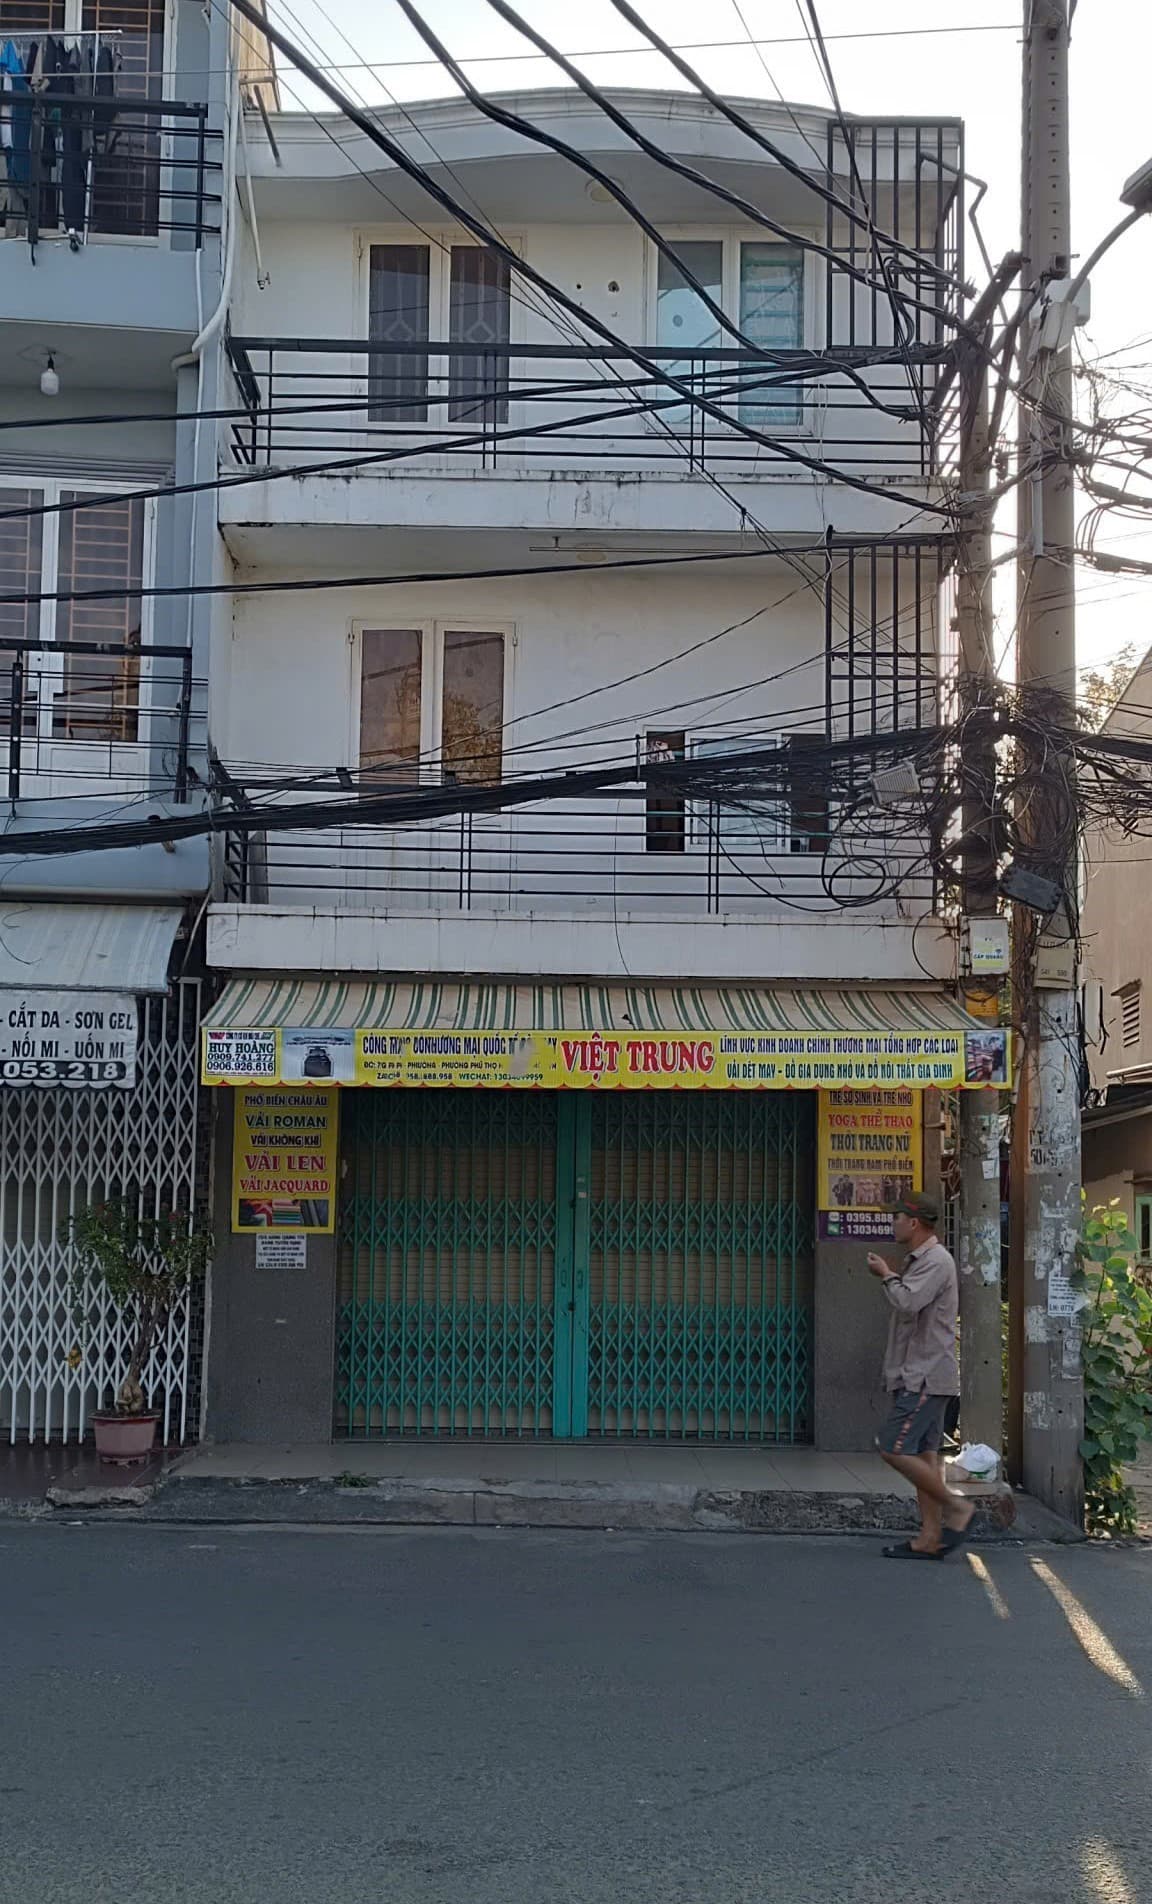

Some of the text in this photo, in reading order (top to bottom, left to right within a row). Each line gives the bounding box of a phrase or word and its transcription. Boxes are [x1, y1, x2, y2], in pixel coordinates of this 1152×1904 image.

[9, 1001, 36, 1028] CẮT
[41, 1010, 60, 1028] DA
[75, 1011, 104, 1030] SƠN
[109, 1012, 133, 1030] GEL
[12, 1031, 36, 1058] NỐI
[41, 1040, 59, 1058] MI
[75, 1032, 104, 1059] UỐN
[109, 1041, 124, 1058] MI
[209, 1040, 274, 1053] HUY HOÀNG
[779, 1038, 805, 1053] DOANH
[561, 1032, 620, 1081] VIỆT
[626, 1041, 715, 1073] TRUNG
[758, 1064, 776, 1079] MAY
[917, 1064, 931, 1079] GIA
[245, 1112, 327, 1128] VẢI ROMAN
[828, 1114, 857, 1128] YOGA
[884, 1115, 913, 1128] THAO
[858, 1134, 893, 1151] TRANG
[245, 1151, 326, 1171] VẢI LEN
[240, 1176, 329, 1193] VẢI JACQUARD
